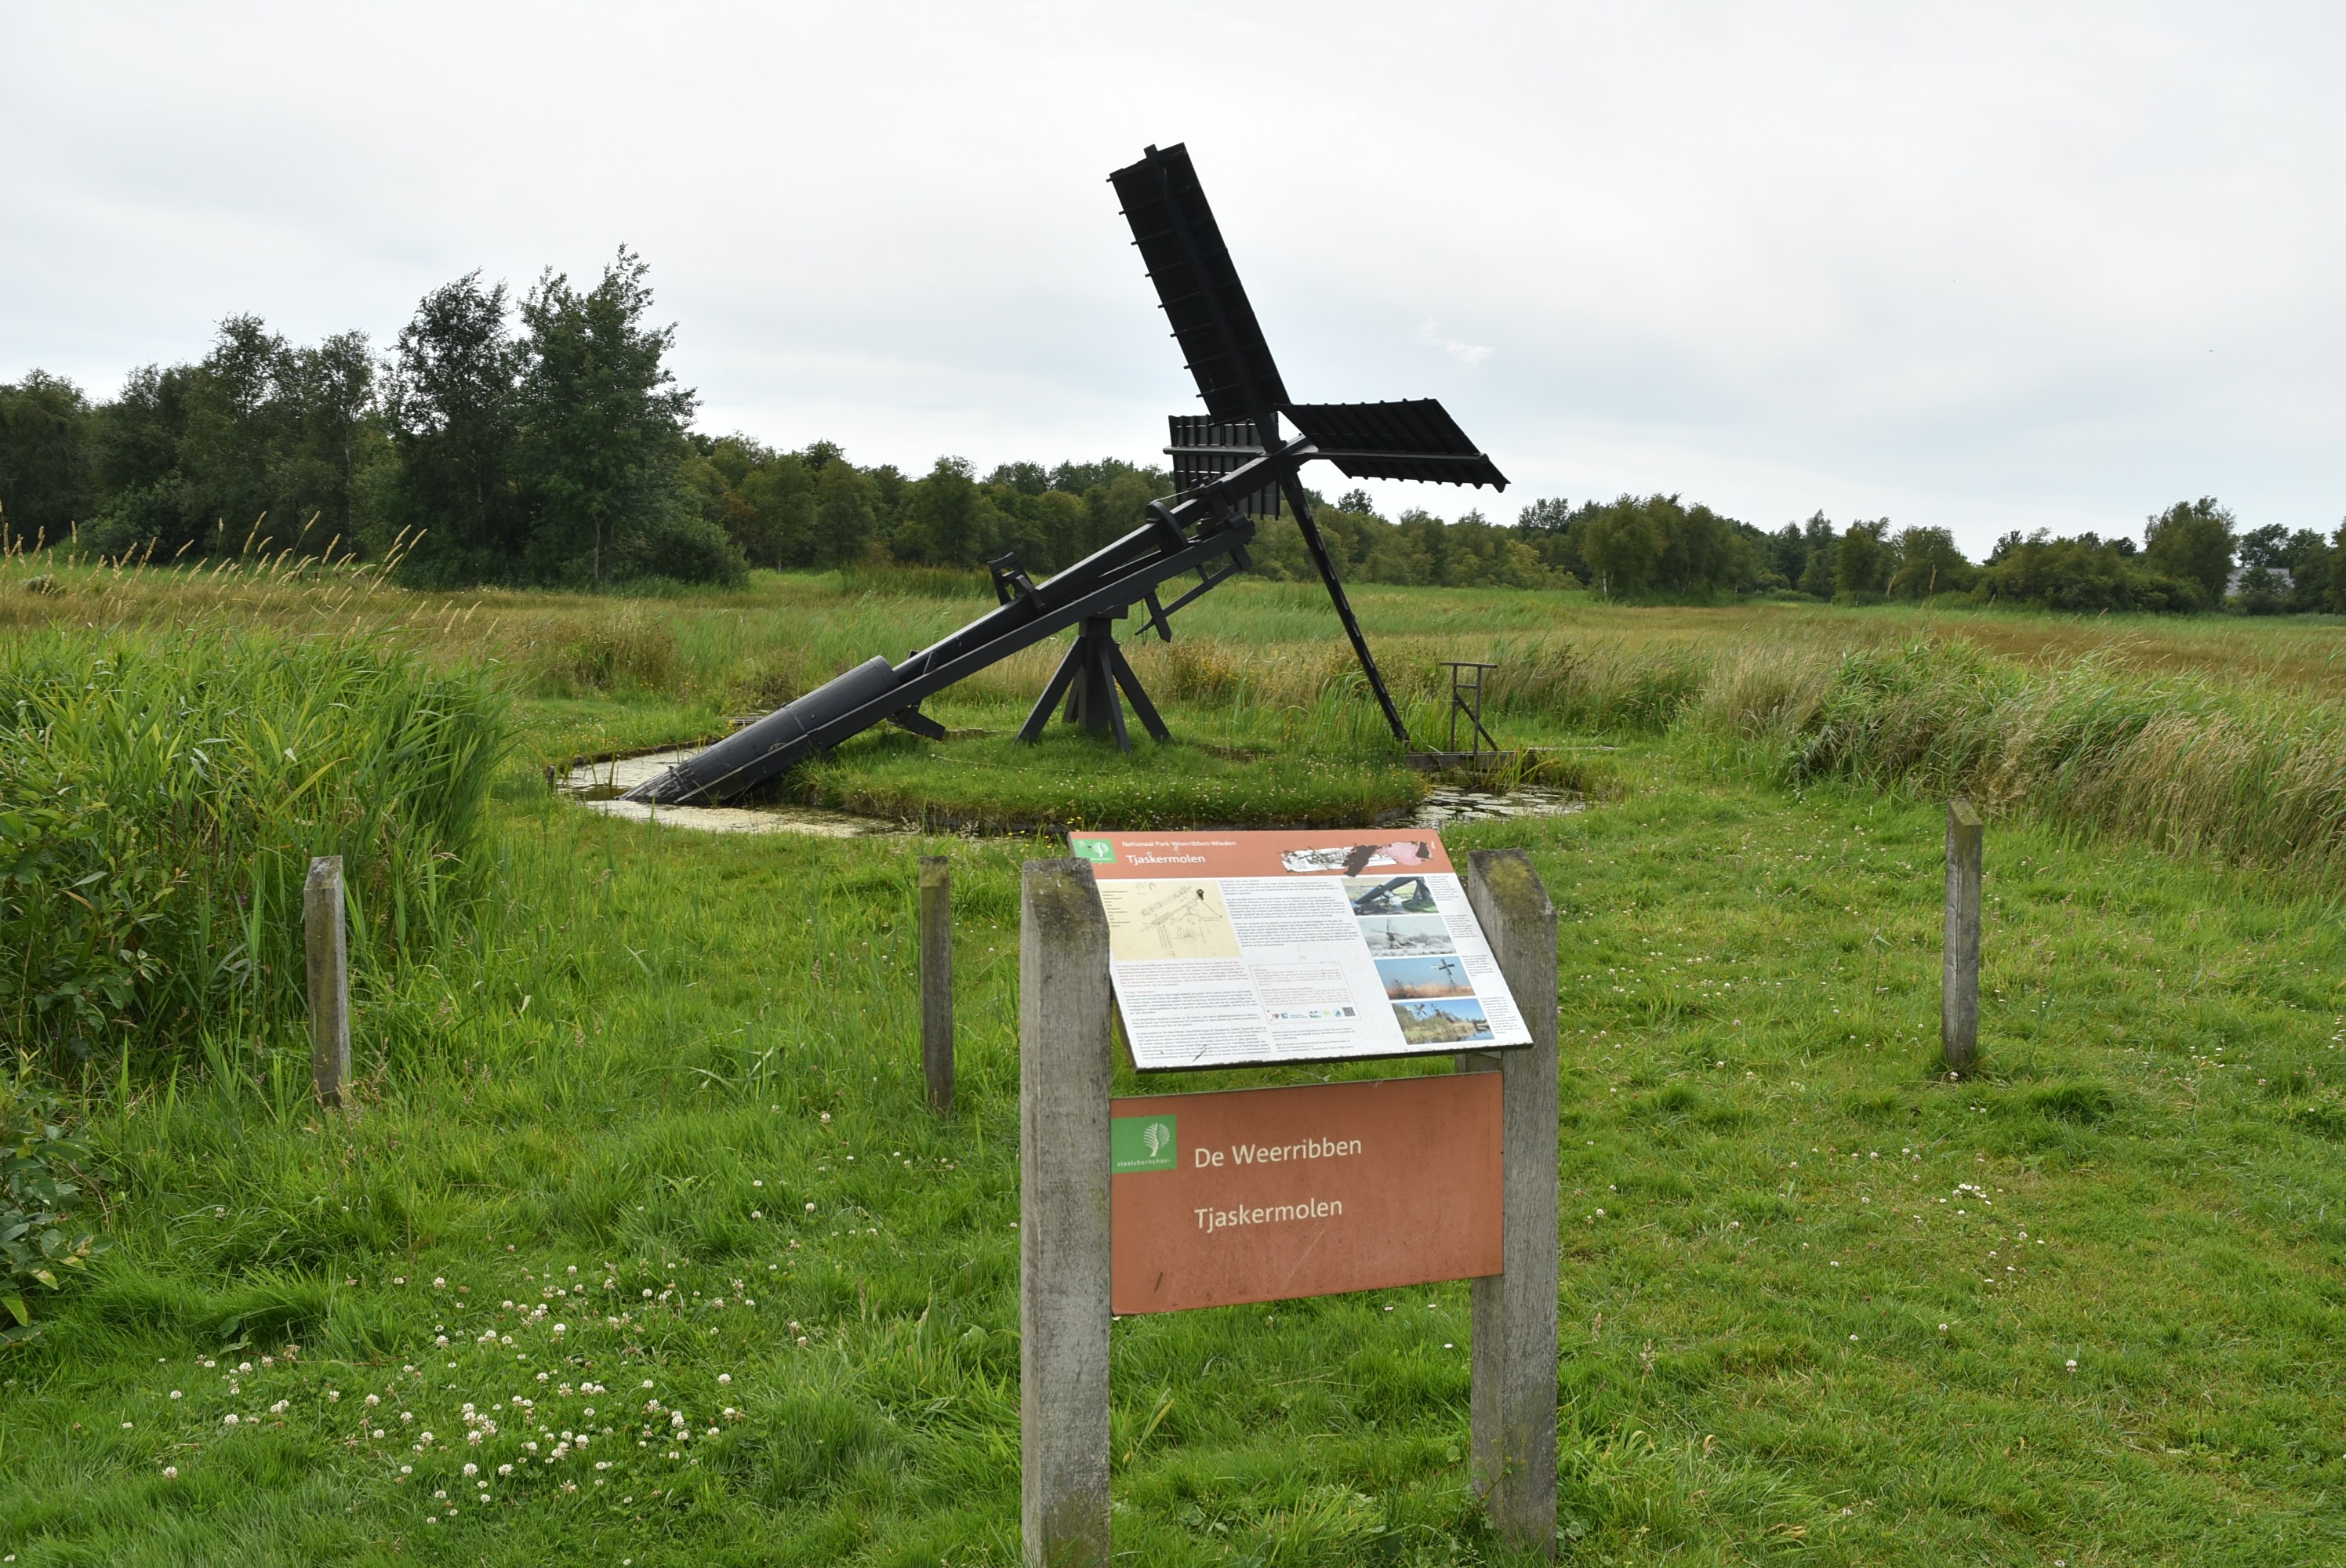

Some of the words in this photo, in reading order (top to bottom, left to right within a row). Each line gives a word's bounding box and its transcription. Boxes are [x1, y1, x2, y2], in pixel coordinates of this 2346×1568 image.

[1126, 853, 1206, 866] Tjaskermolen
[1194, 1147, 1225, 1168] De
[1232, 1137, 1362, 1165] Weerribben
[1194, 1197, 1343, 1233] Tjaskermolen
